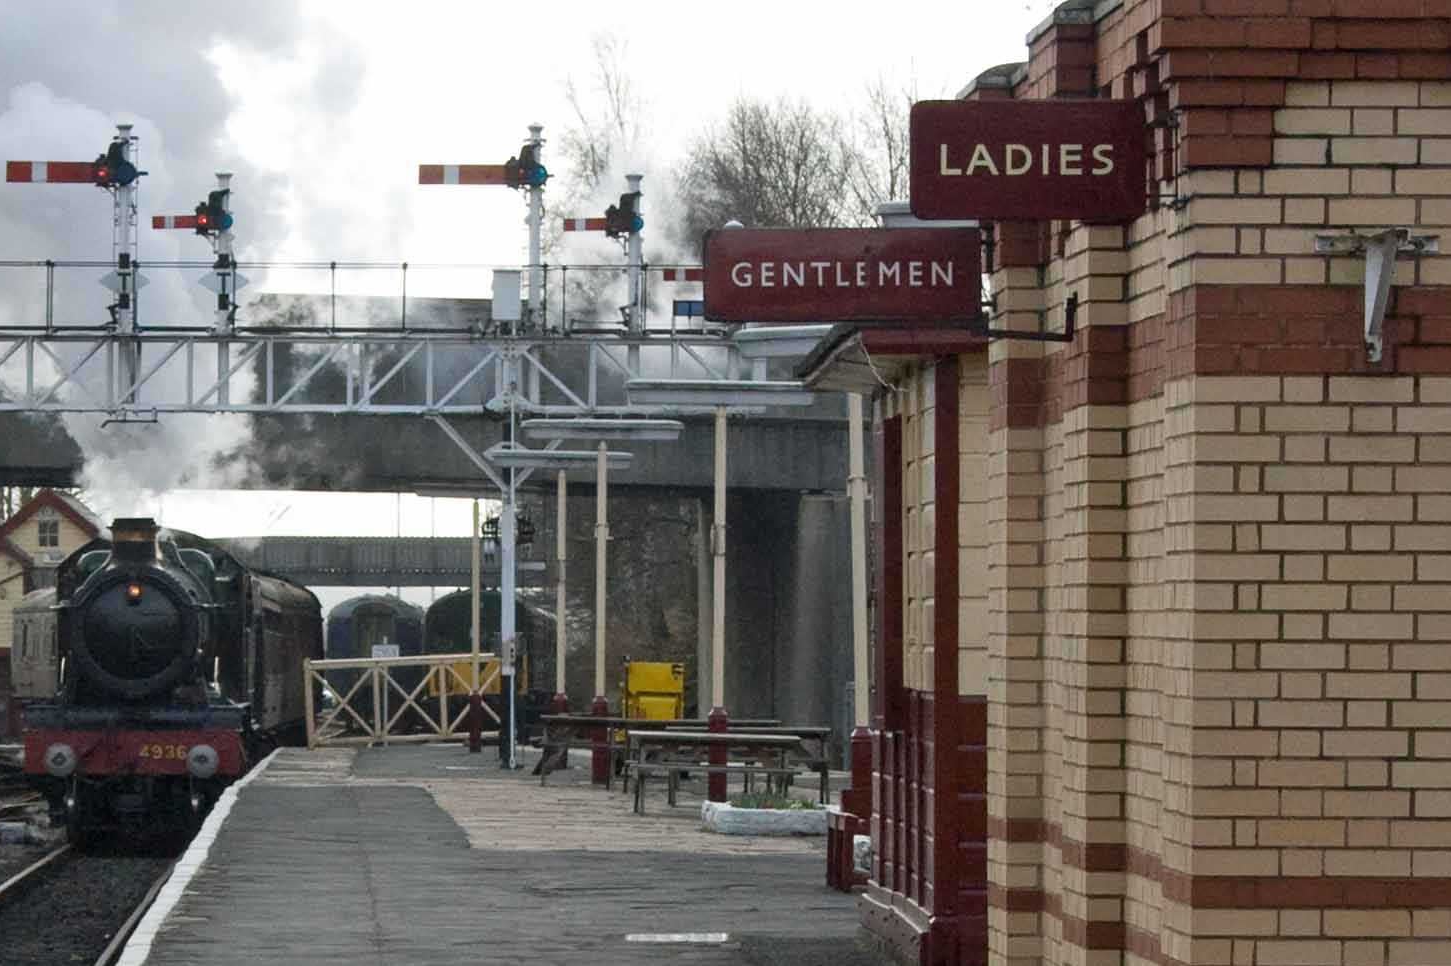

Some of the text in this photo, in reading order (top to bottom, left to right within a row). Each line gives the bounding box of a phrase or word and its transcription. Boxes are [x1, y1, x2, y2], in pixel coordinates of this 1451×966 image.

[940, 144, 1114, 175] LADIES
[731, 261, 953, 287] GENTLEMEN
[139, 744, 188, 759] 4936
